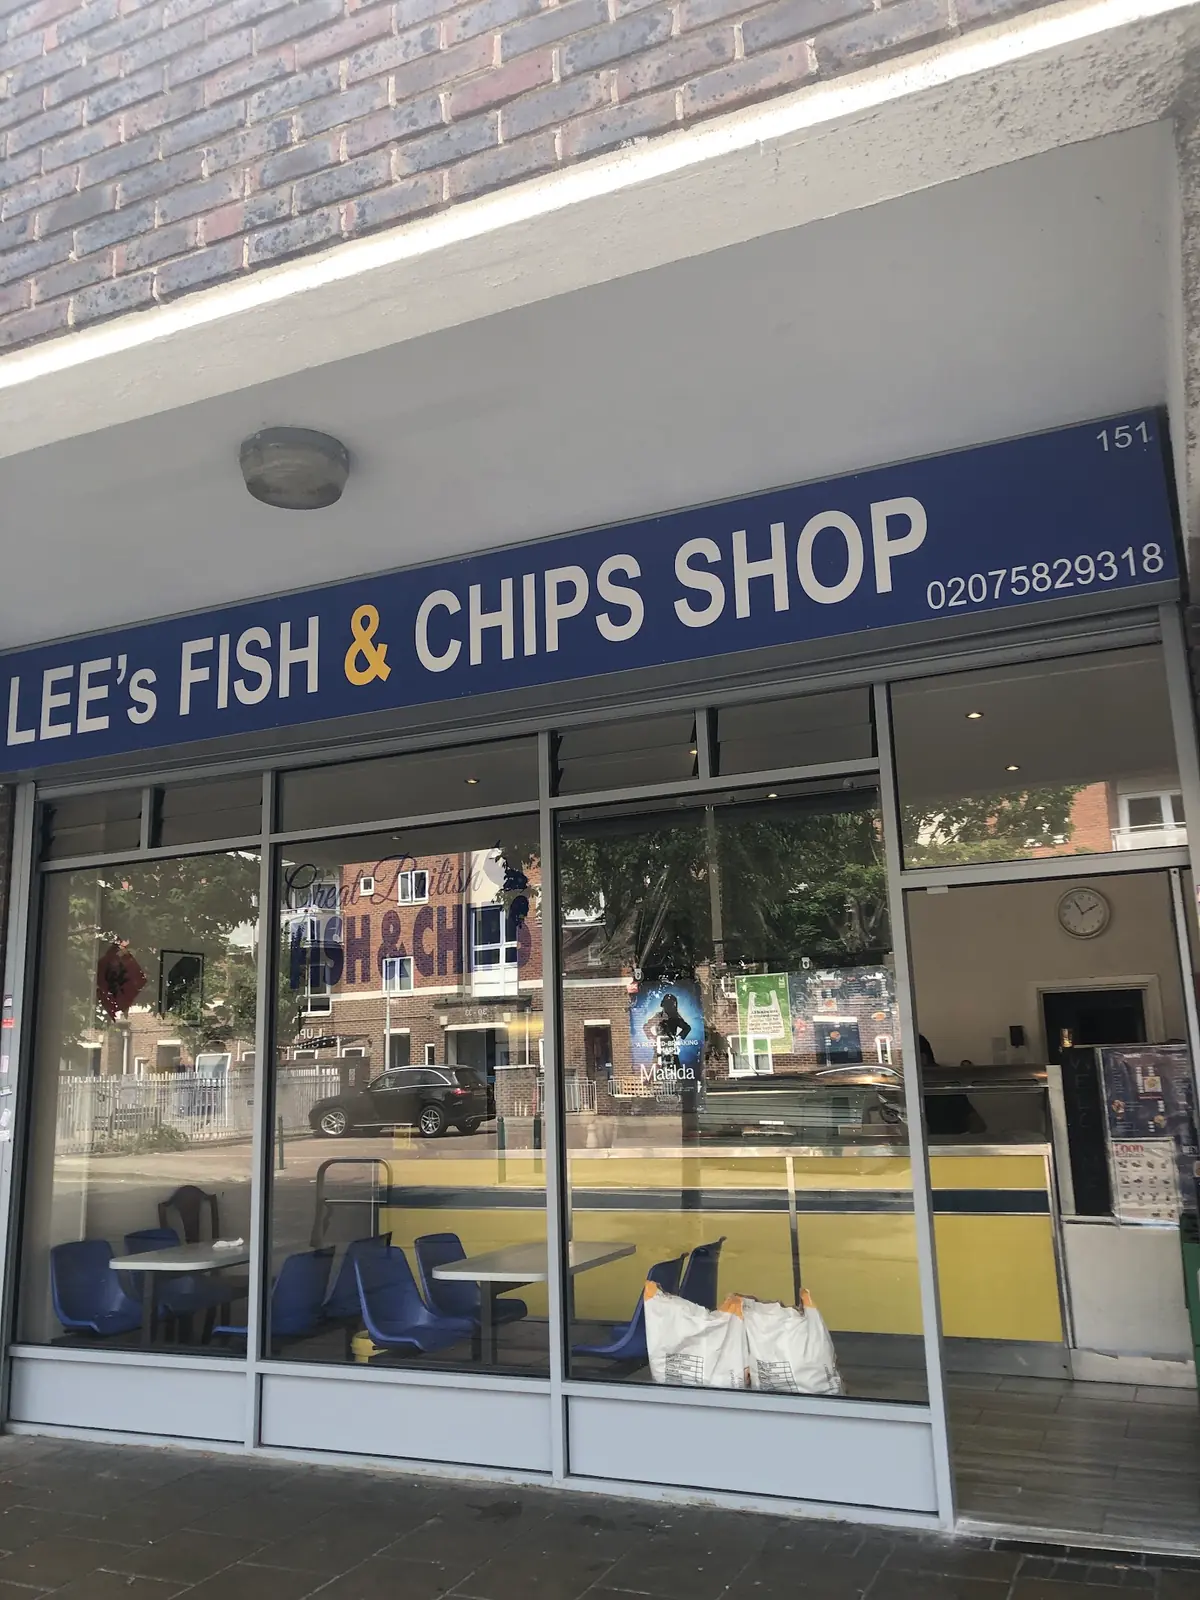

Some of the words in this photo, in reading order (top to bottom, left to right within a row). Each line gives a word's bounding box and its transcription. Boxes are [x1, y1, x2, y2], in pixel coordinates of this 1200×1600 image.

[1096, 421, 1149, 451] 151
[926, 542, 1164, 610] 02075829318
[7, 653, 157, 746] LEE's
[179, 615, 319, 715] FISH
[344, 604, 391, 686] &
[414, 553, 644, 672] CHIPS
[674, 496, 927, 627] SHOP
[640, 1063, 695, 1081] Matilda
